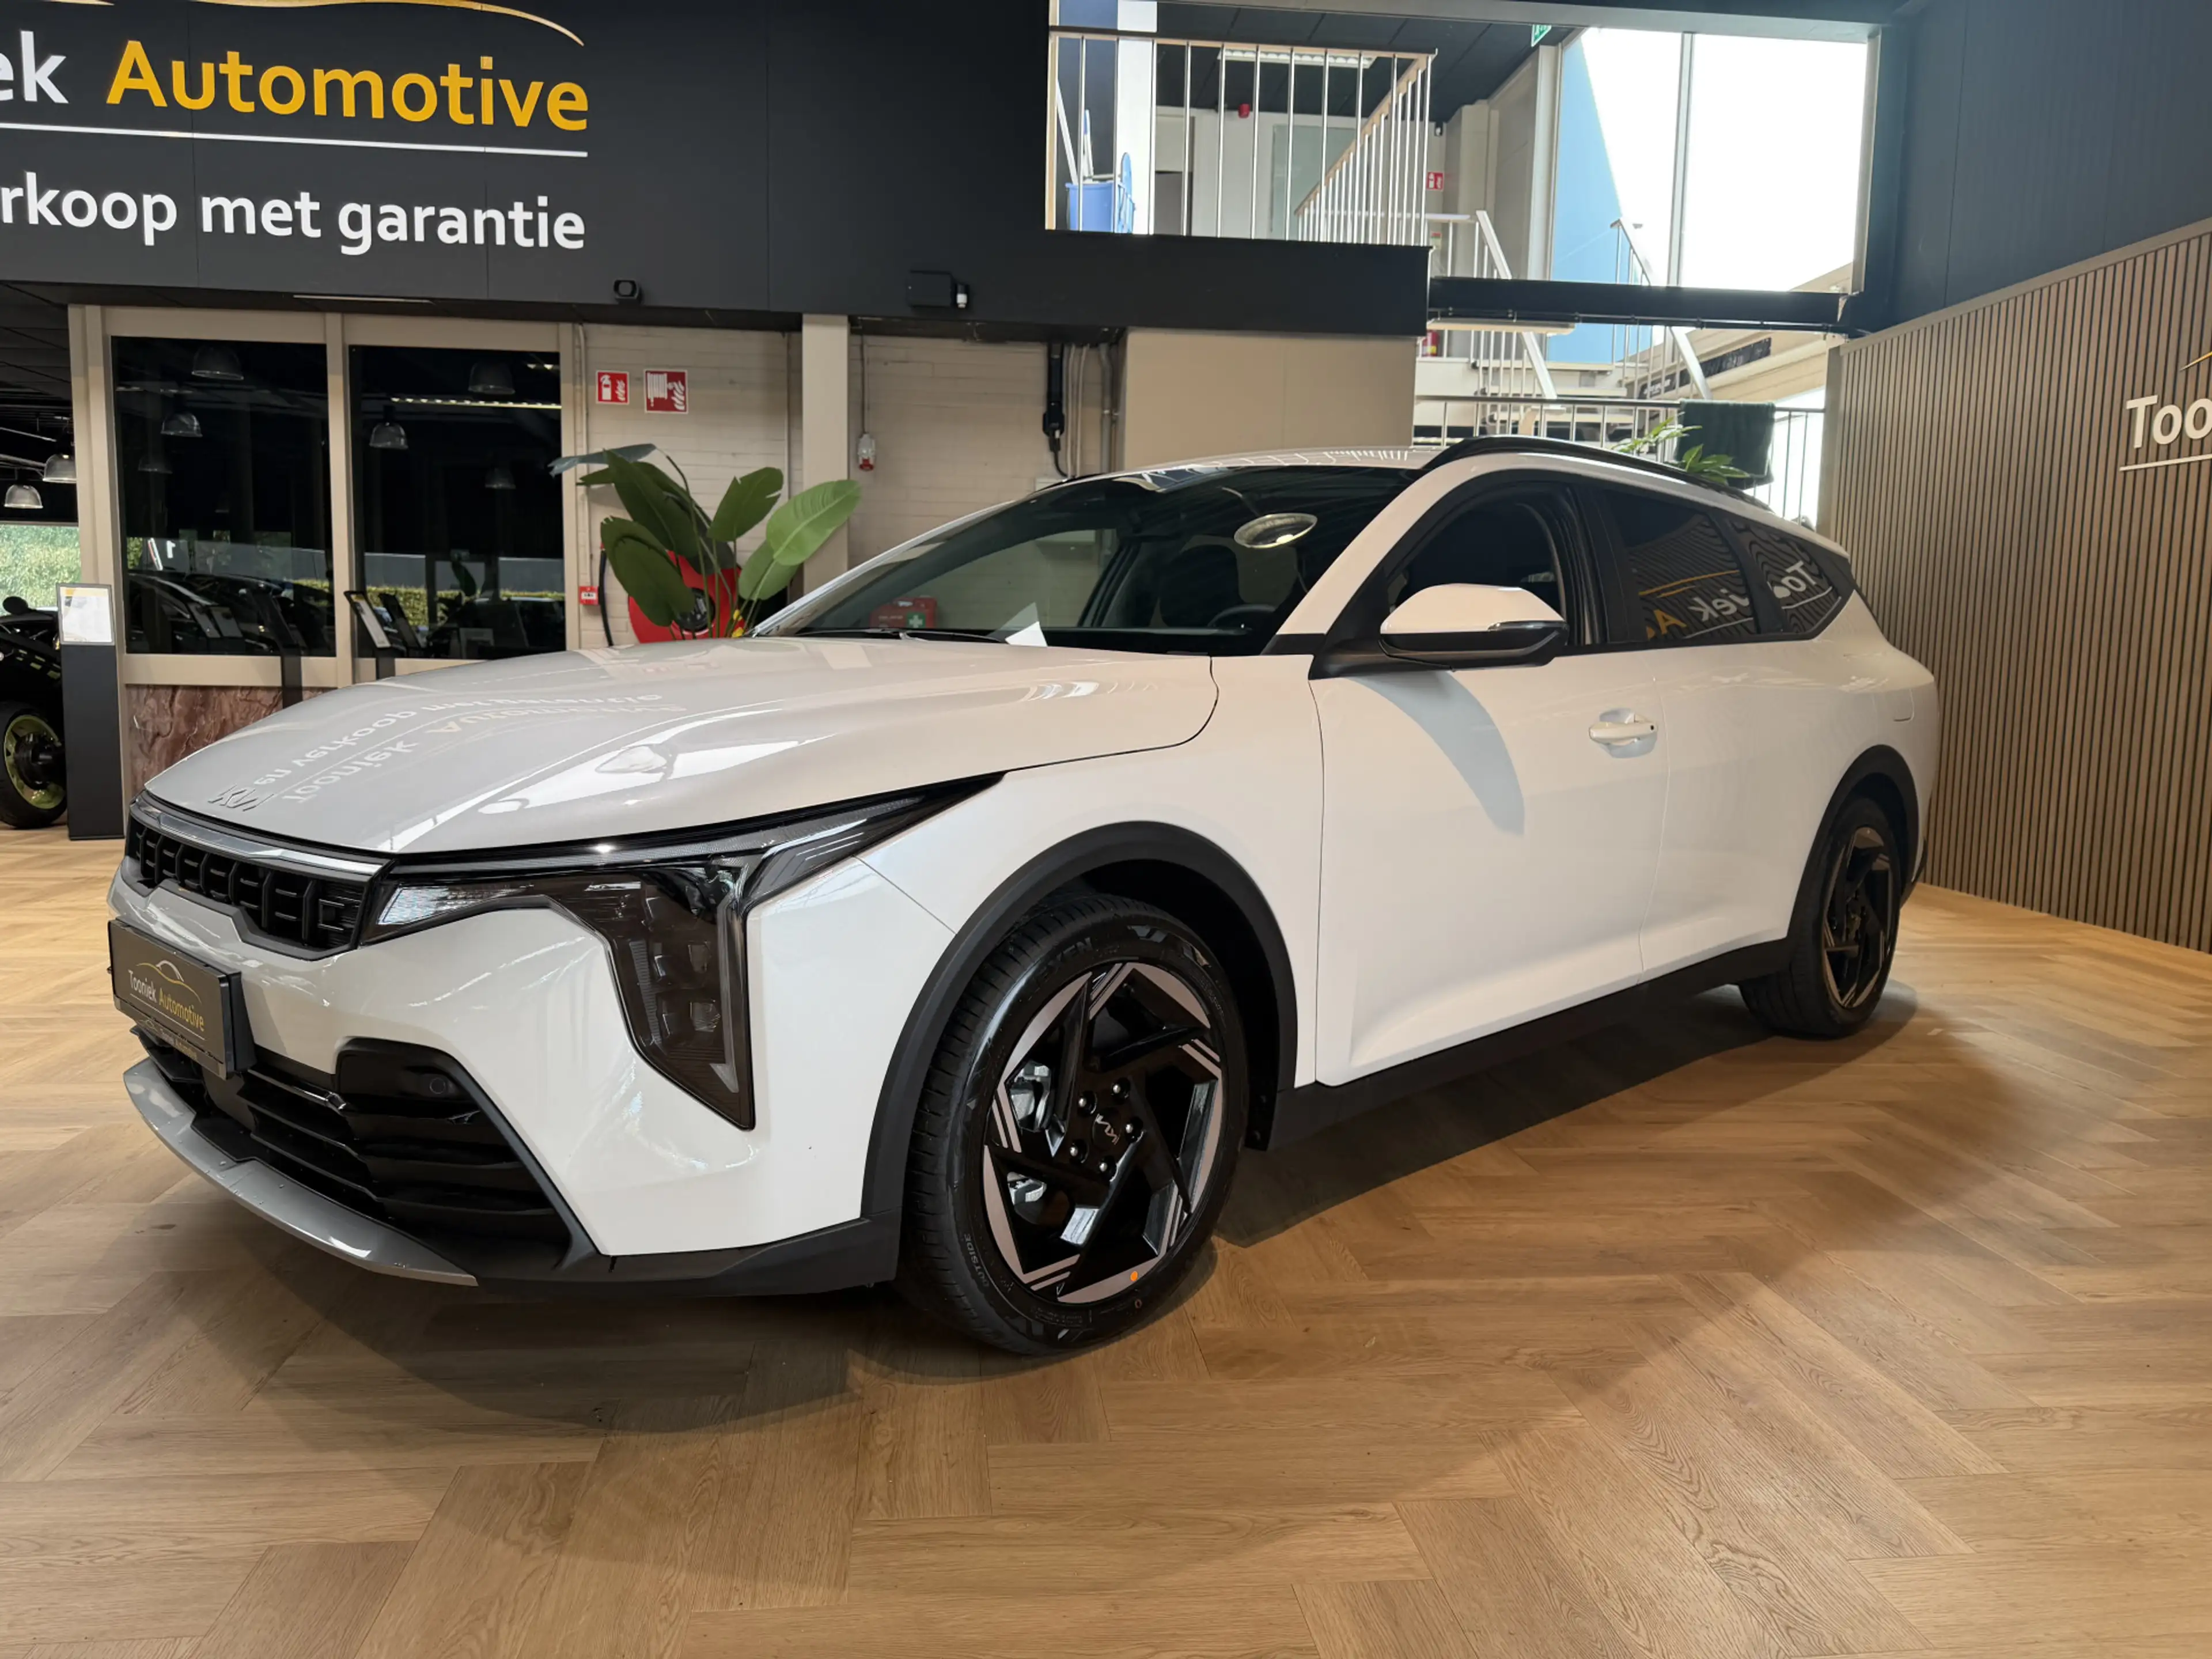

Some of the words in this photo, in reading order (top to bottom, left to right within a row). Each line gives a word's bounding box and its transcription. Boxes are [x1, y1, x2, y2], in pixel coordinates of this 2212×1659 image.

[107, 41, 588, 130] Automotive
[1, 172, 177, 245] rkoop
[202, 192, 321, 237] met
[339, 196, 584, 255] garantie
[2126, 395, 2212, 449] Too
[128, 969, 157, 1003] Tooniek
[159, 988, 204, 1032] Automotive
[964, 1233, 989, 1287] OUTSIDE
